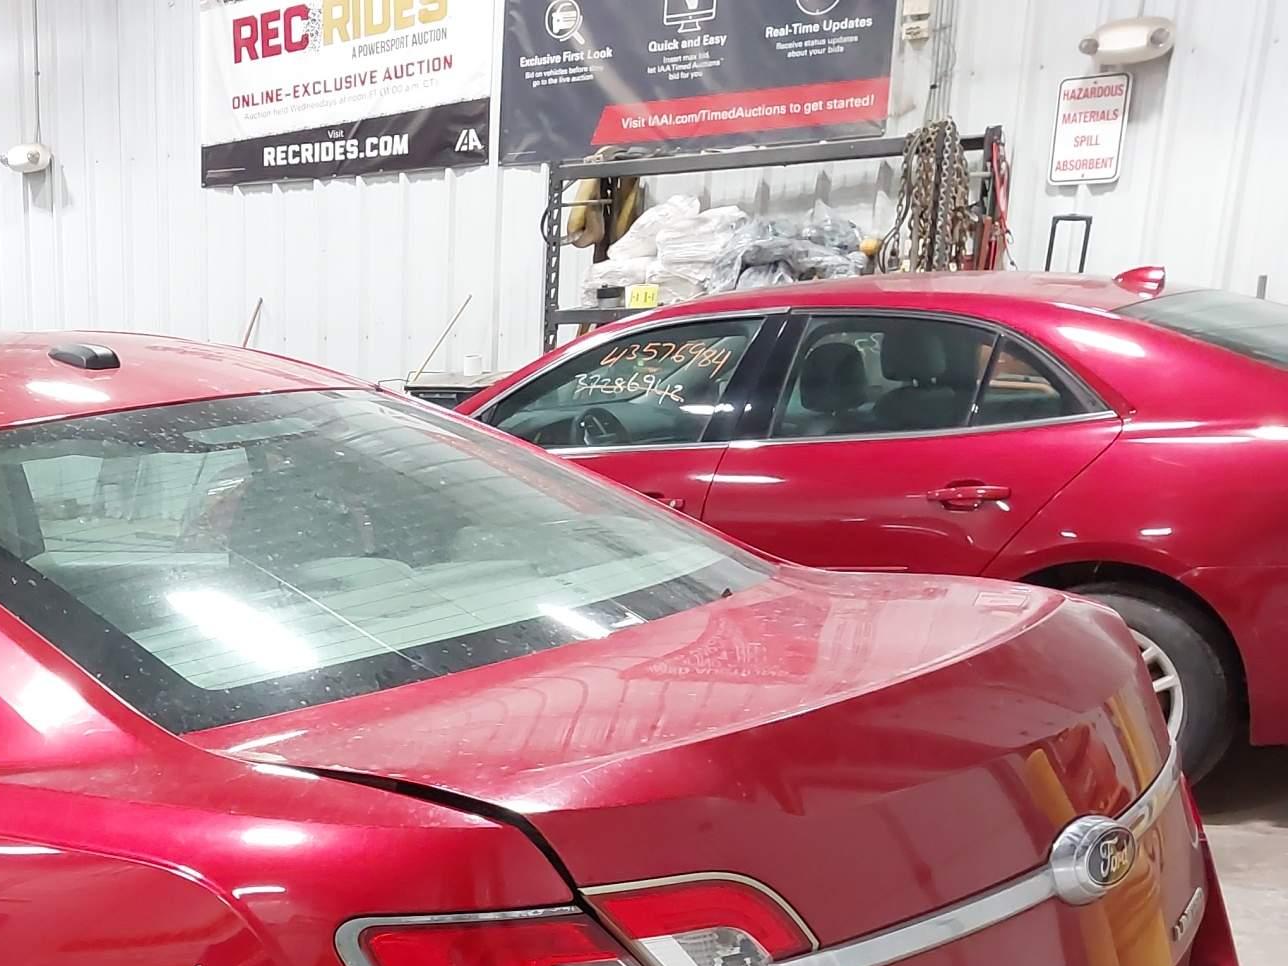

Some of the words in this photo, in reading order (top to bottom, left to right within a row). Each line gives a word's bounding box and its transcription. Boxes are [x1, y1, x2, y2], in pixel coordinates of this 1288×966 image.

[233, 4, 310, 64] REC
[765, 23, 820, 38] Real-Time
[823, 17, 872, 33] Updates
[352, 47, 357, 60] A
[358, 35, 409, 58] POWERSPORT
[412, 28, 447, 47] AUCTION
[648, 39, 679, 52] Quick
[681, 36, 700, 49] and
[703, 34, 727, 46] Easy
[804, 38, 826, 47] status
[520, 53, 561, 67] Exclusive
[562, 51, 584, 62] First
[587, 47, 613, 59] Look
[787, 49, 808, 58] about
[809, 47, 826, 56] your
[232, 70, 377, 110] ONLINE-EXCLUSIVE
[383, 54, 453, 81] AUCTION
[691, 71, 703, 79] you
[1063, 84, 1124, 101] HAZARDOUS
[621, 117, 646, 129] Visit
[648, 105, 787, 127] IAAI.com/TimedAuctions
[789, 104, 801, 114] to
[804, 102, 823, 115] get
[826, 94, 875, 109] started!
[1062, 108, 1119, 124] MATERIALS
[327, 130, 344, 139] Visit
[1074, 134, 1101, 148] SPILL
[263, 133, 409, 166] RECRIDES.COM
[1055, 157, 1114, 172] ABSORBENT
[600, 342, 732, 379] 43576984
[1099, 836, 1128, 878] Ford
